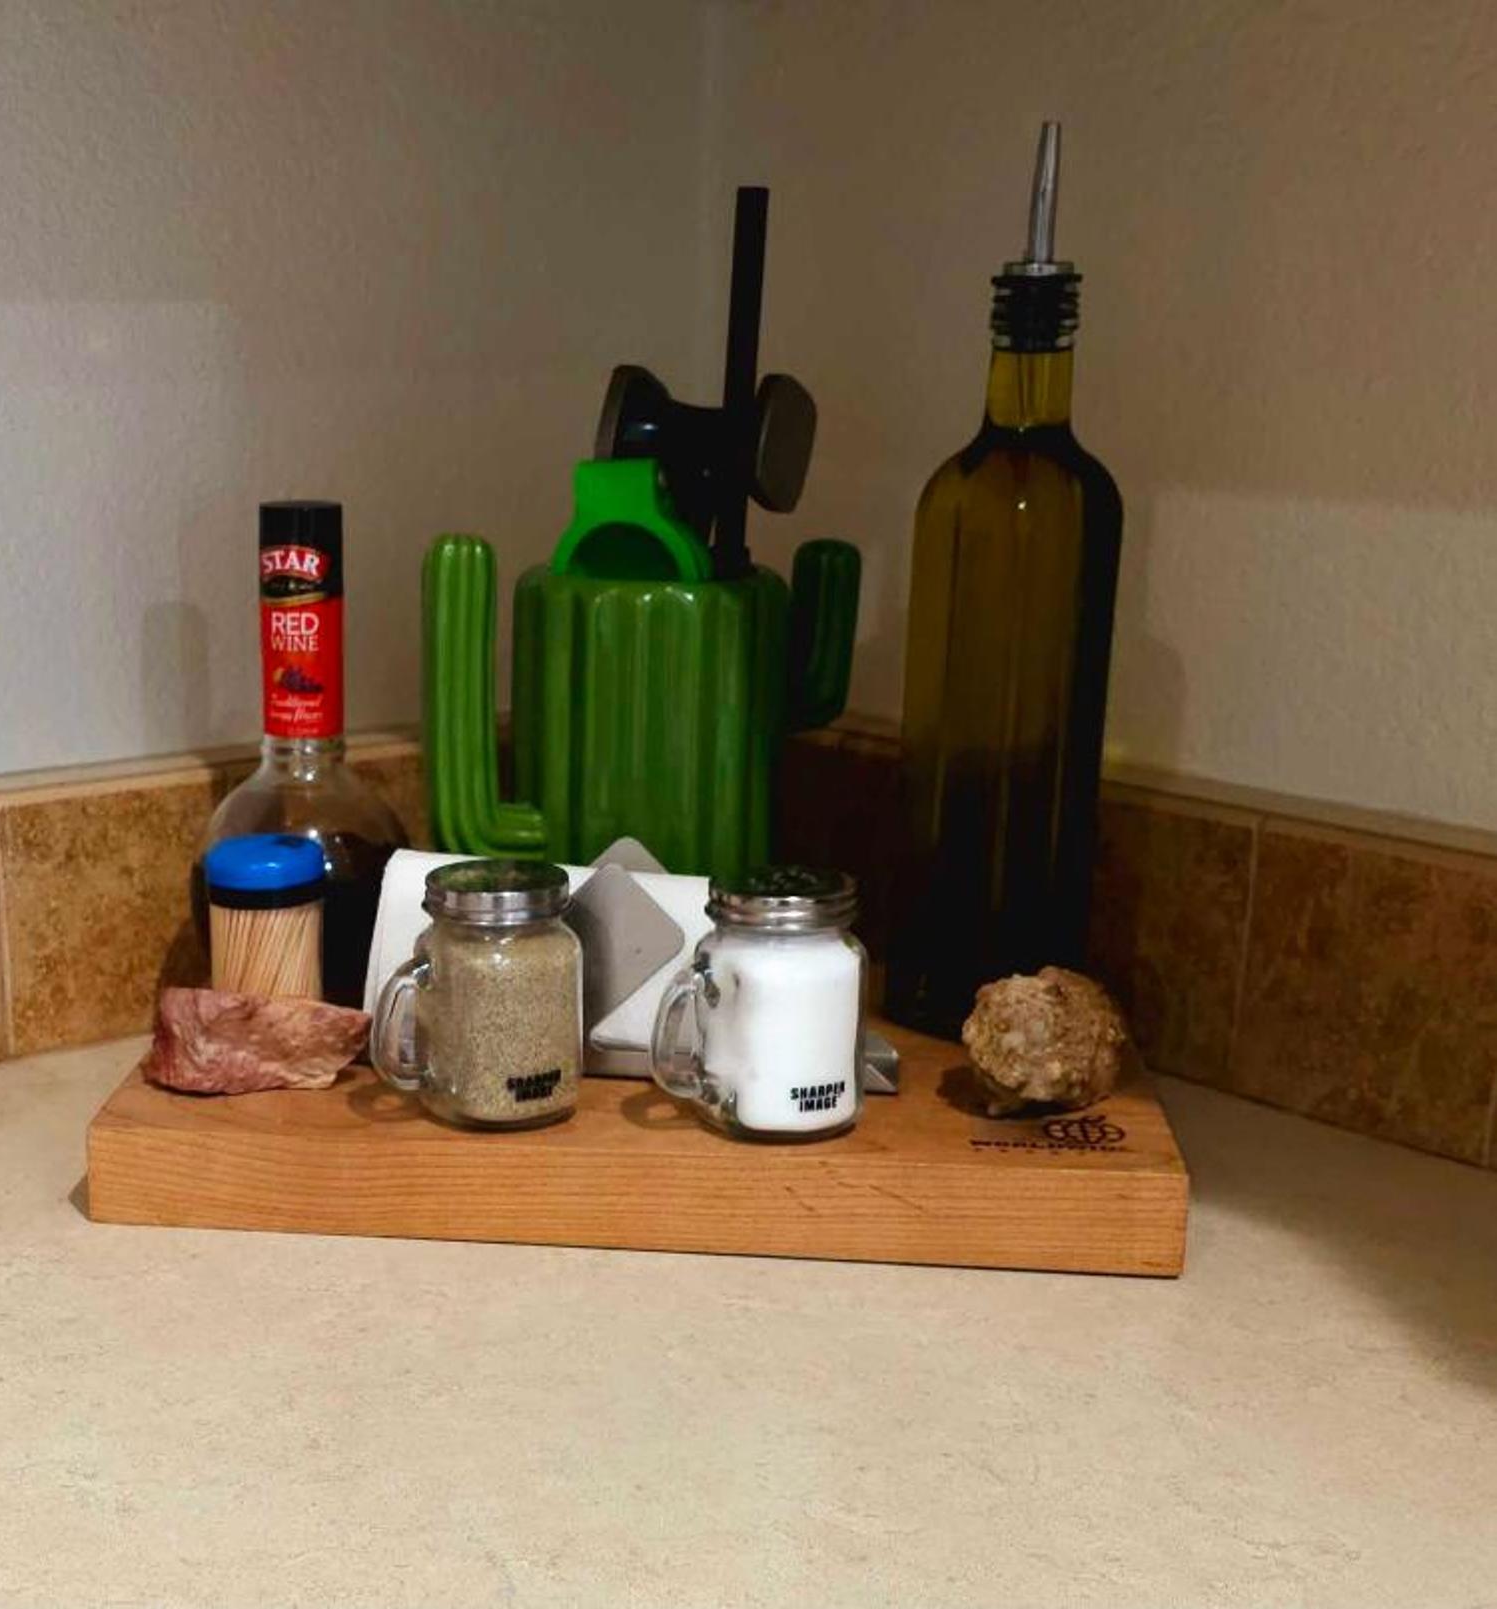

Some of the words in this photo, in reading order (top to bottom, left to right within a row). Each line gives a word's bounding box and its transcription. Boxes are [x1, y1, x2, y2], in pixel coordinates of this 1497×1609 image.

[262, 550, 320, 576] STAR
[271, 611, 320, 636] RED
[271, 635, 319, 652] WINE
[790, 1081, 846, 1100] SHARPER
[799, 1095, 838, 1112] IMAGE
